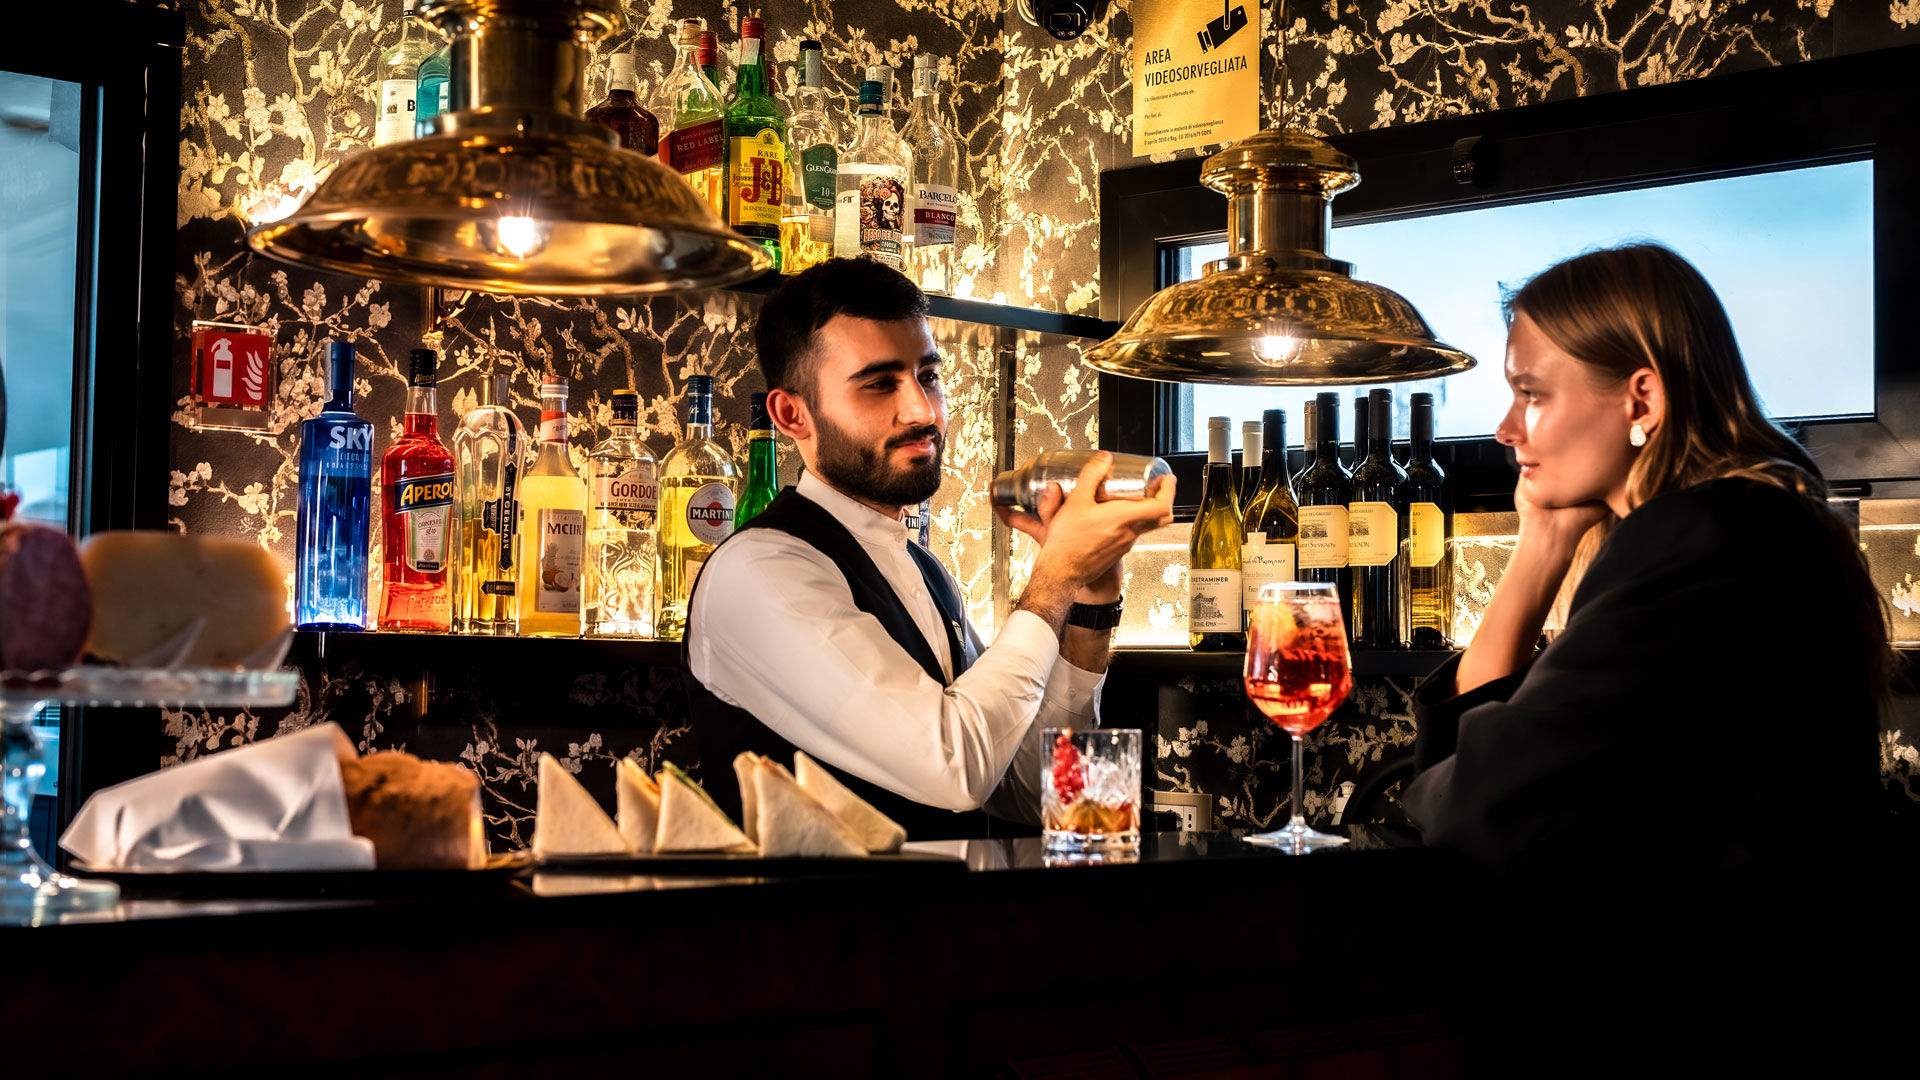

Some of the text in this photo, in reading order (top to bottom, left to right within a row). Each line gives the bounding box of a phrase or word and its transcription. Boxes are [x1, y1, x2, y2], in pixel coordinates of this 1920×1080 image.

[1144, 48, 1171, 66] AREA
[1144, 55, 1248, 87] VIDEOSORVEGLIATA
[676, 141, 696, 152] RED
[697, 133, 724, 147] LABEL
[757, 150, 779, 160] RARE
[741, 156, 783, 207] J&B
[821, 186, 830, 197] 10
[919, 189, 958, 204] BARCELÓ
[925, 211, 955, 222] BLANCO
[864, 228, 881, 242] BESO
[882, 229, 892, 240] DEL
[400, 481, 454, 507] APEROL
[692, 508, 733, 520] MARTINI
